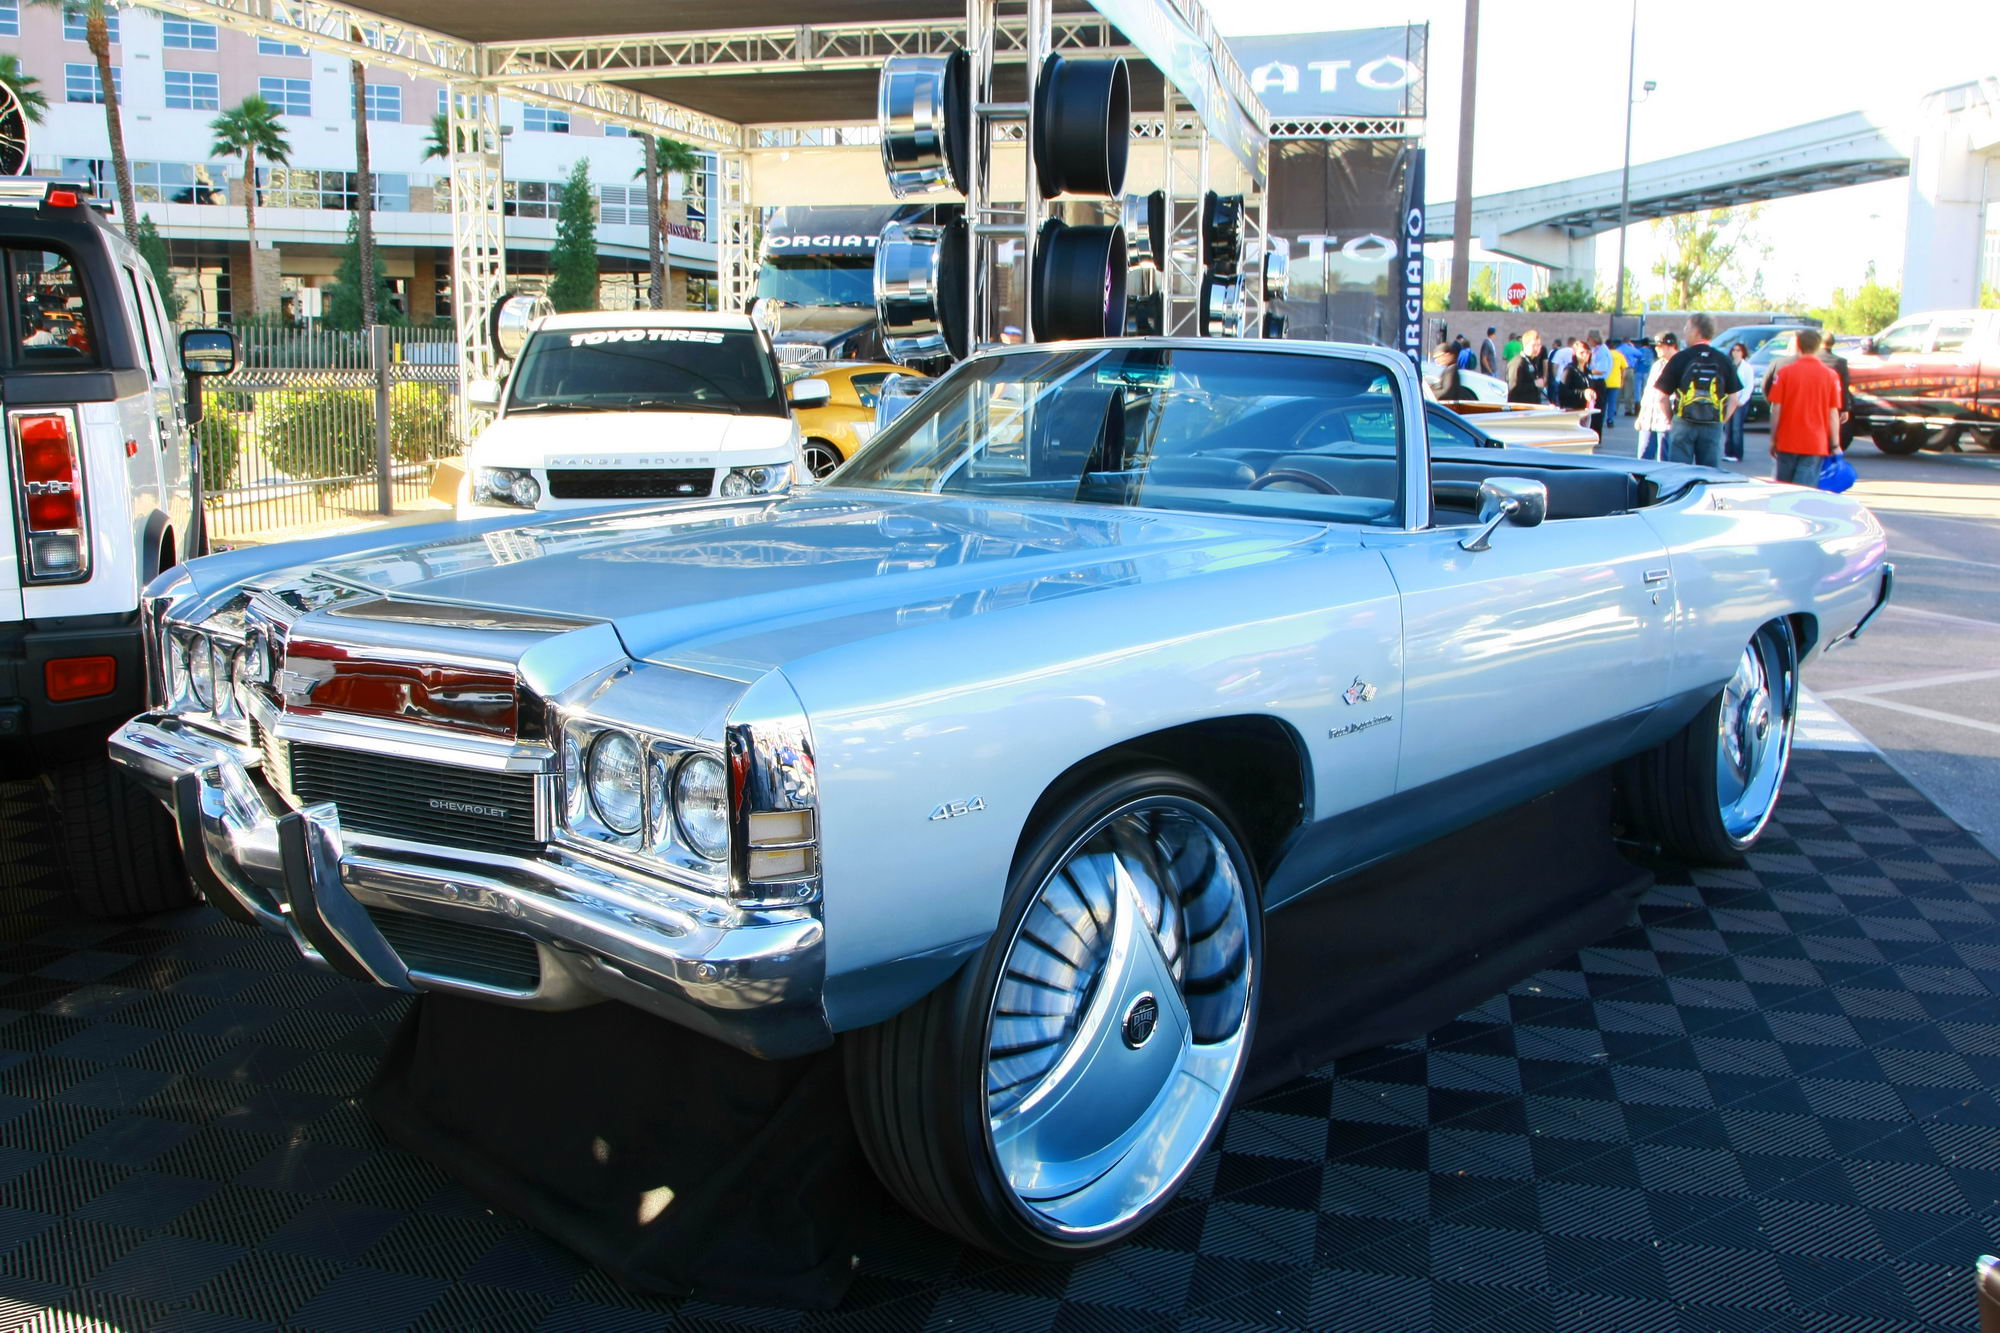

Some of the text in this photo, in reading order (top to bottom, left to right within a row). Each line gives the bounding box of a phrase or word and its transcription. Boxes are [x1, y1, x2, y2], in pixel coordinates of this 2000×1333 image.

[1508, 289, 1526, 300] STOP
[570, 330, 724, 347] TOYO TIRES
[551, 457, 709, 465] RANGE ROVER
[430, 799, 507, 817] CHEVROLET
[928, 795, 985, 820] 454
